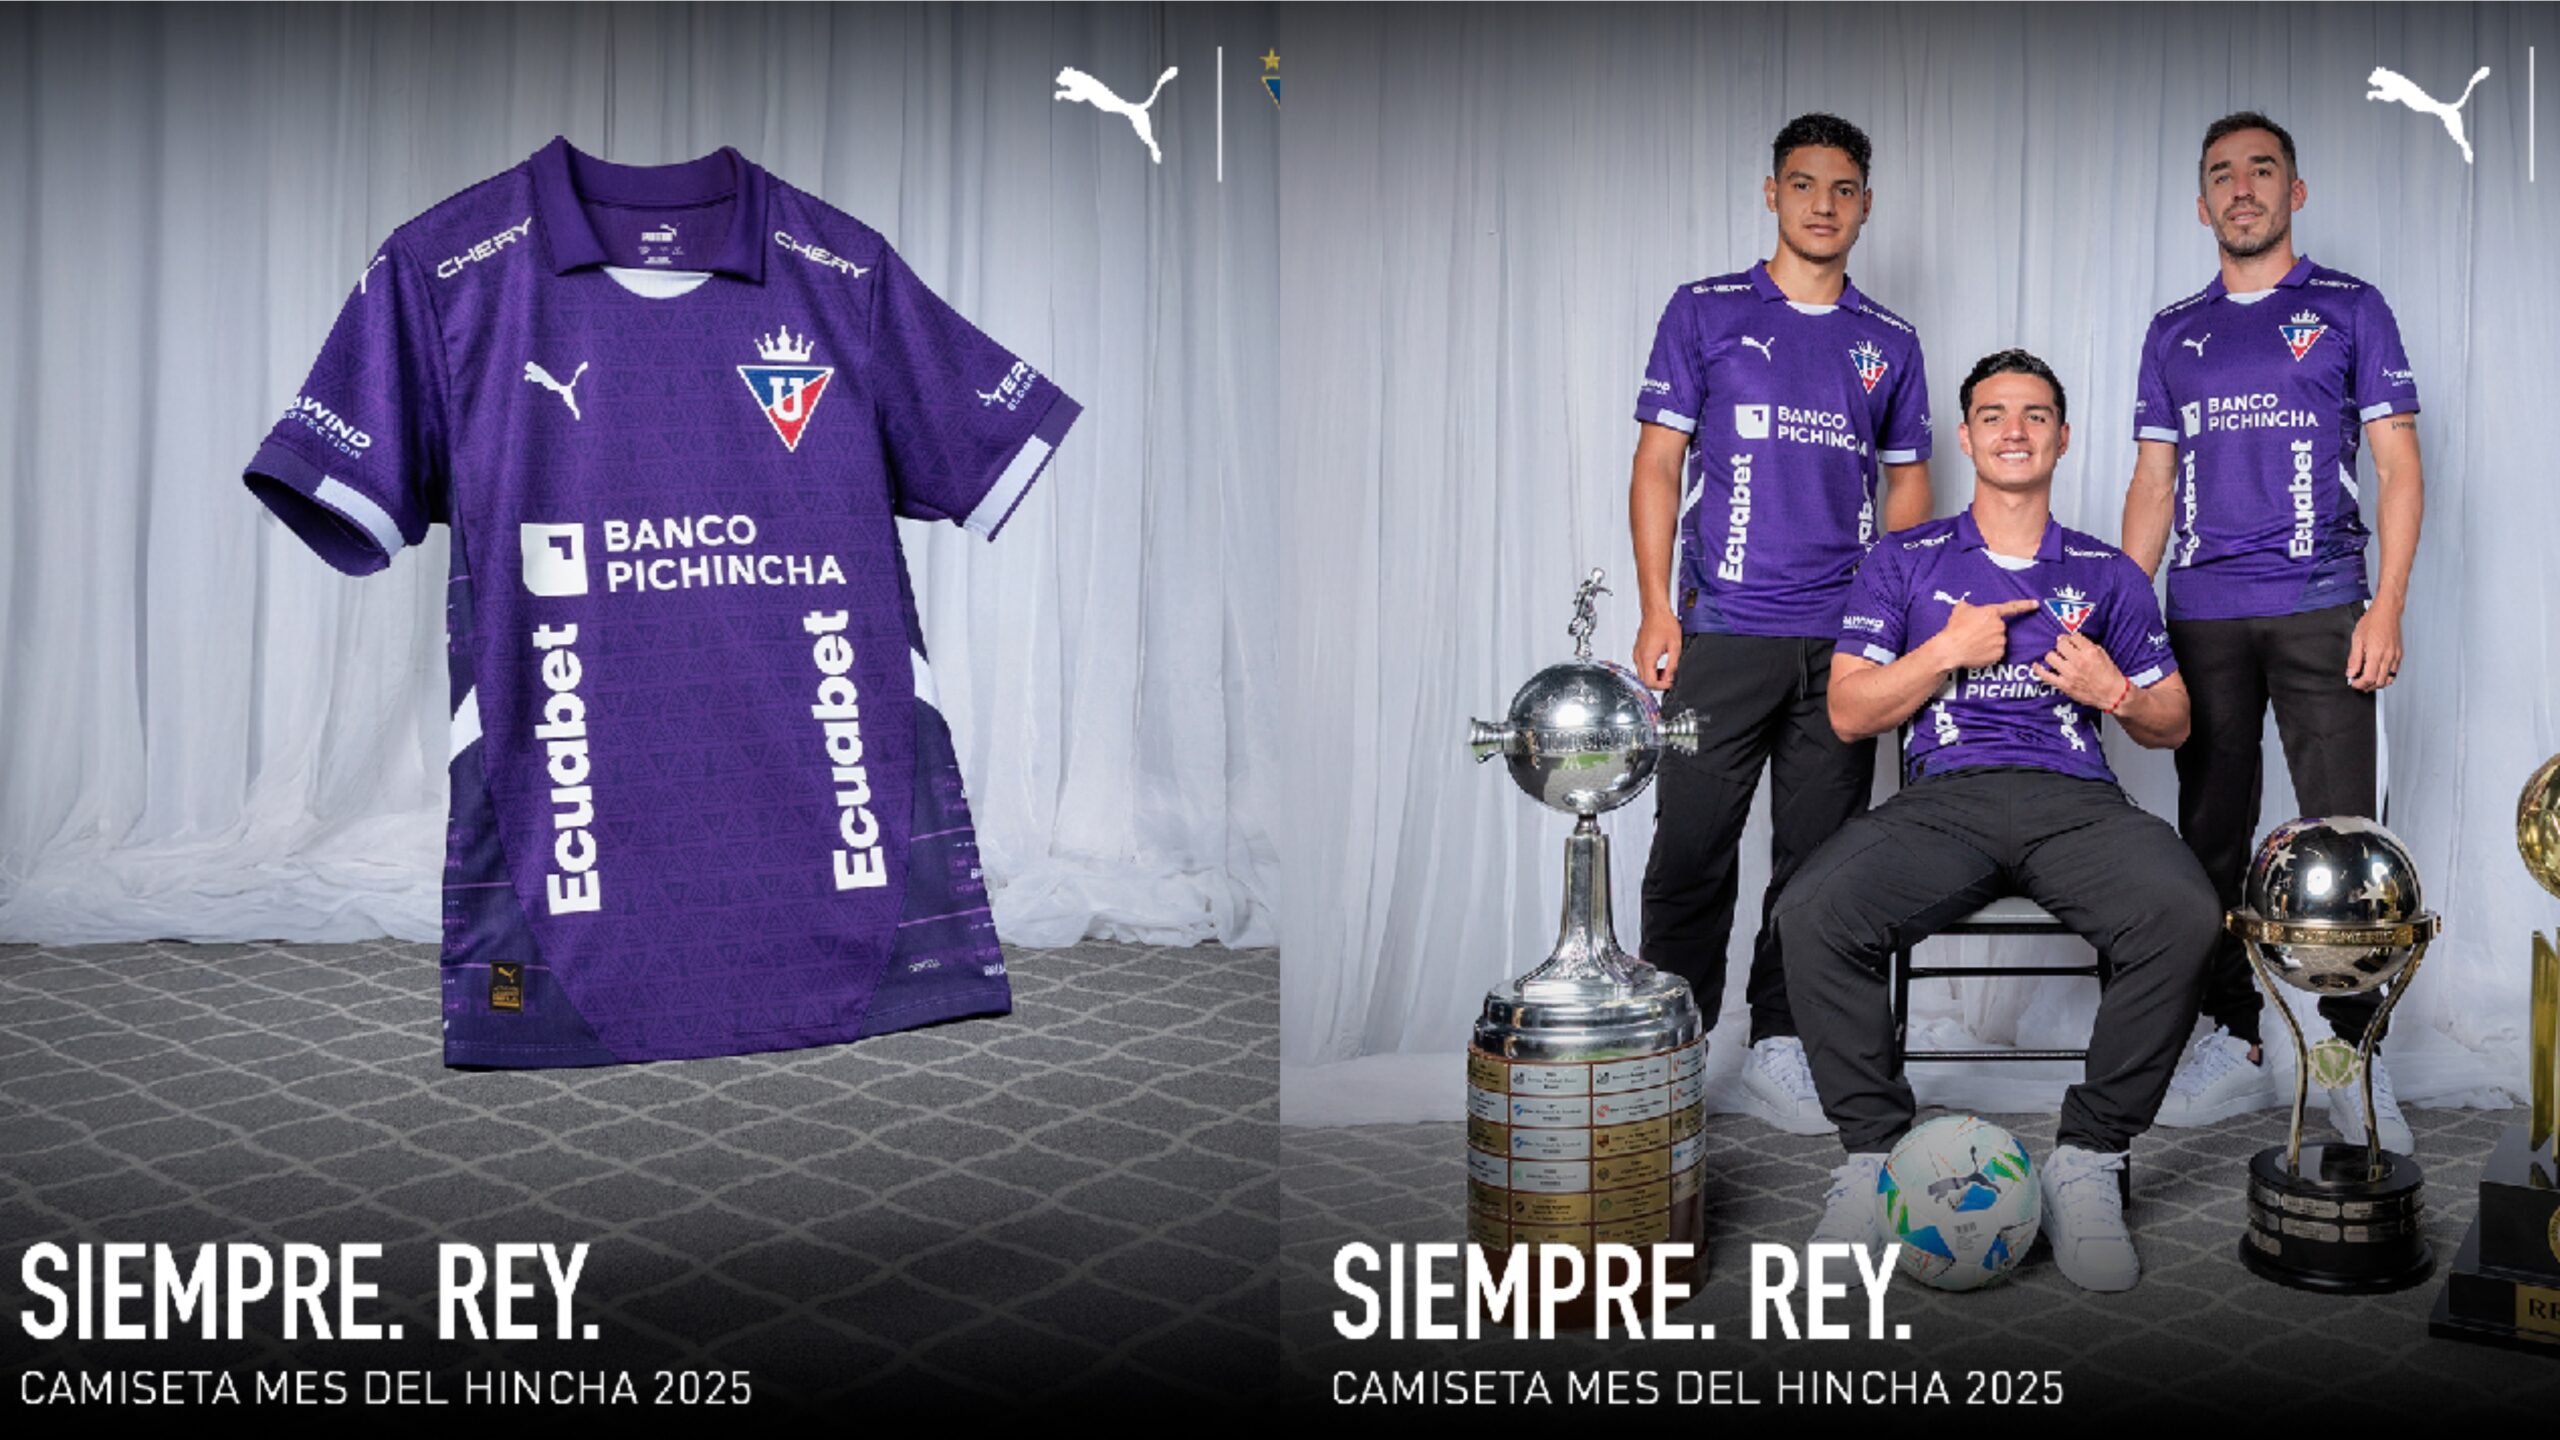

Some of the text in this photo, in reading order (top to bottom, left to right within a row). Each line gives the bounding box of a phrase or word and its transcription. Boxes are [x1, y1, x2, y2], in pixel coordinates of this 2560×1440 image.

[438, 218, 531, 278] CHERY
[775, 230, 870, 278] CHERY
[768, 376, 806, 422] U
[1778, 406, 1847, 431] BANCO
[2208, 394, 2279, 414] BANCO
[2208, 410, 2319, 432] PICHINCHA
[1717, 453, 1753, 583] Ecuabet
[2288, 439, 2314, 558] Ecuabet
[603, 514, 757, 552] BANCO
[606, 555, 847, 592] PICHINCHA
[532, 623, 601, 916] Ecuabet
[803, 609, 888, 891] Ecuabet
